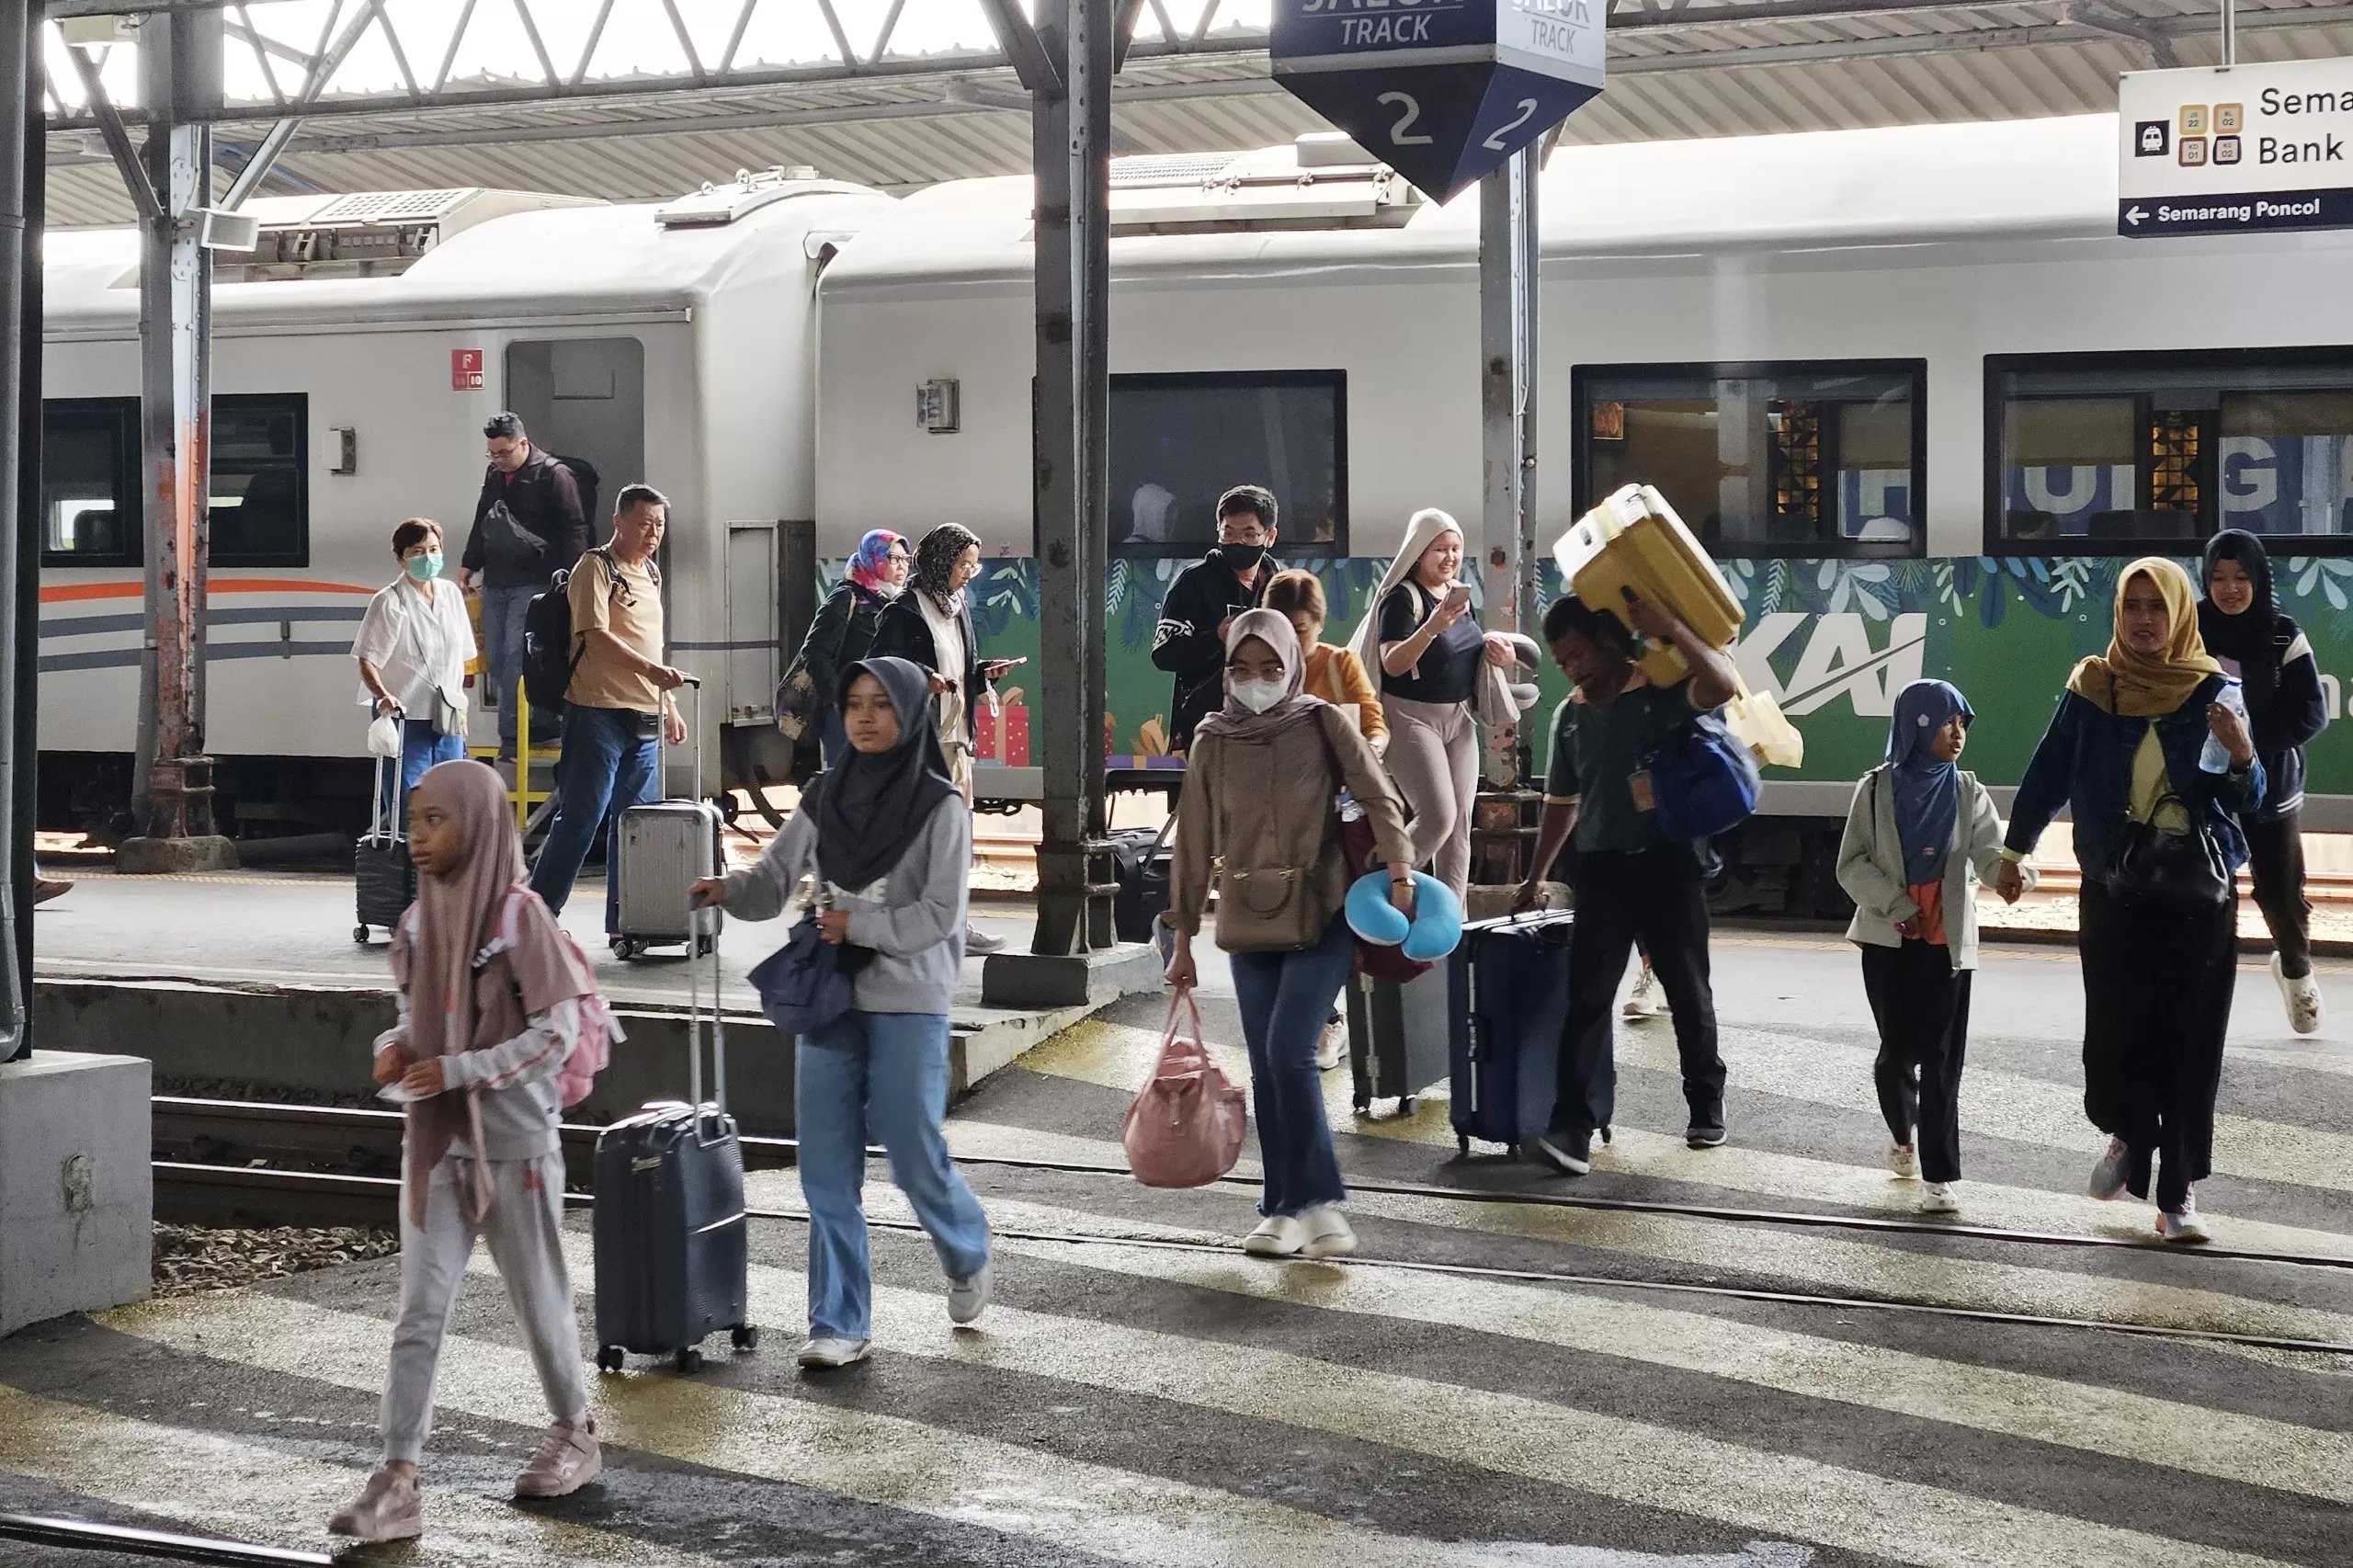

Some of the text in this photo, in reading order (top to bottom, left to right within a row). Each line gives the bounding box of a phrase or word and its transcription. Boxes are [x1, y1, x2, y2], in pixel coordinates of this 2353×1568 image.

[1341, 15, 1433, 45] TRACK
[1531, 18, 1576, 54] TRACK
[1377, 91, 1433, 145] 2
[1482, 97, 1539, 151] 2
[2222, 150, 2234, 158] 02
[2259, 133, 2344, 164] Bank
[2158, 199, 2320, 222] Semarang Poncol
[1733, 613, 1927, 716] KAI
